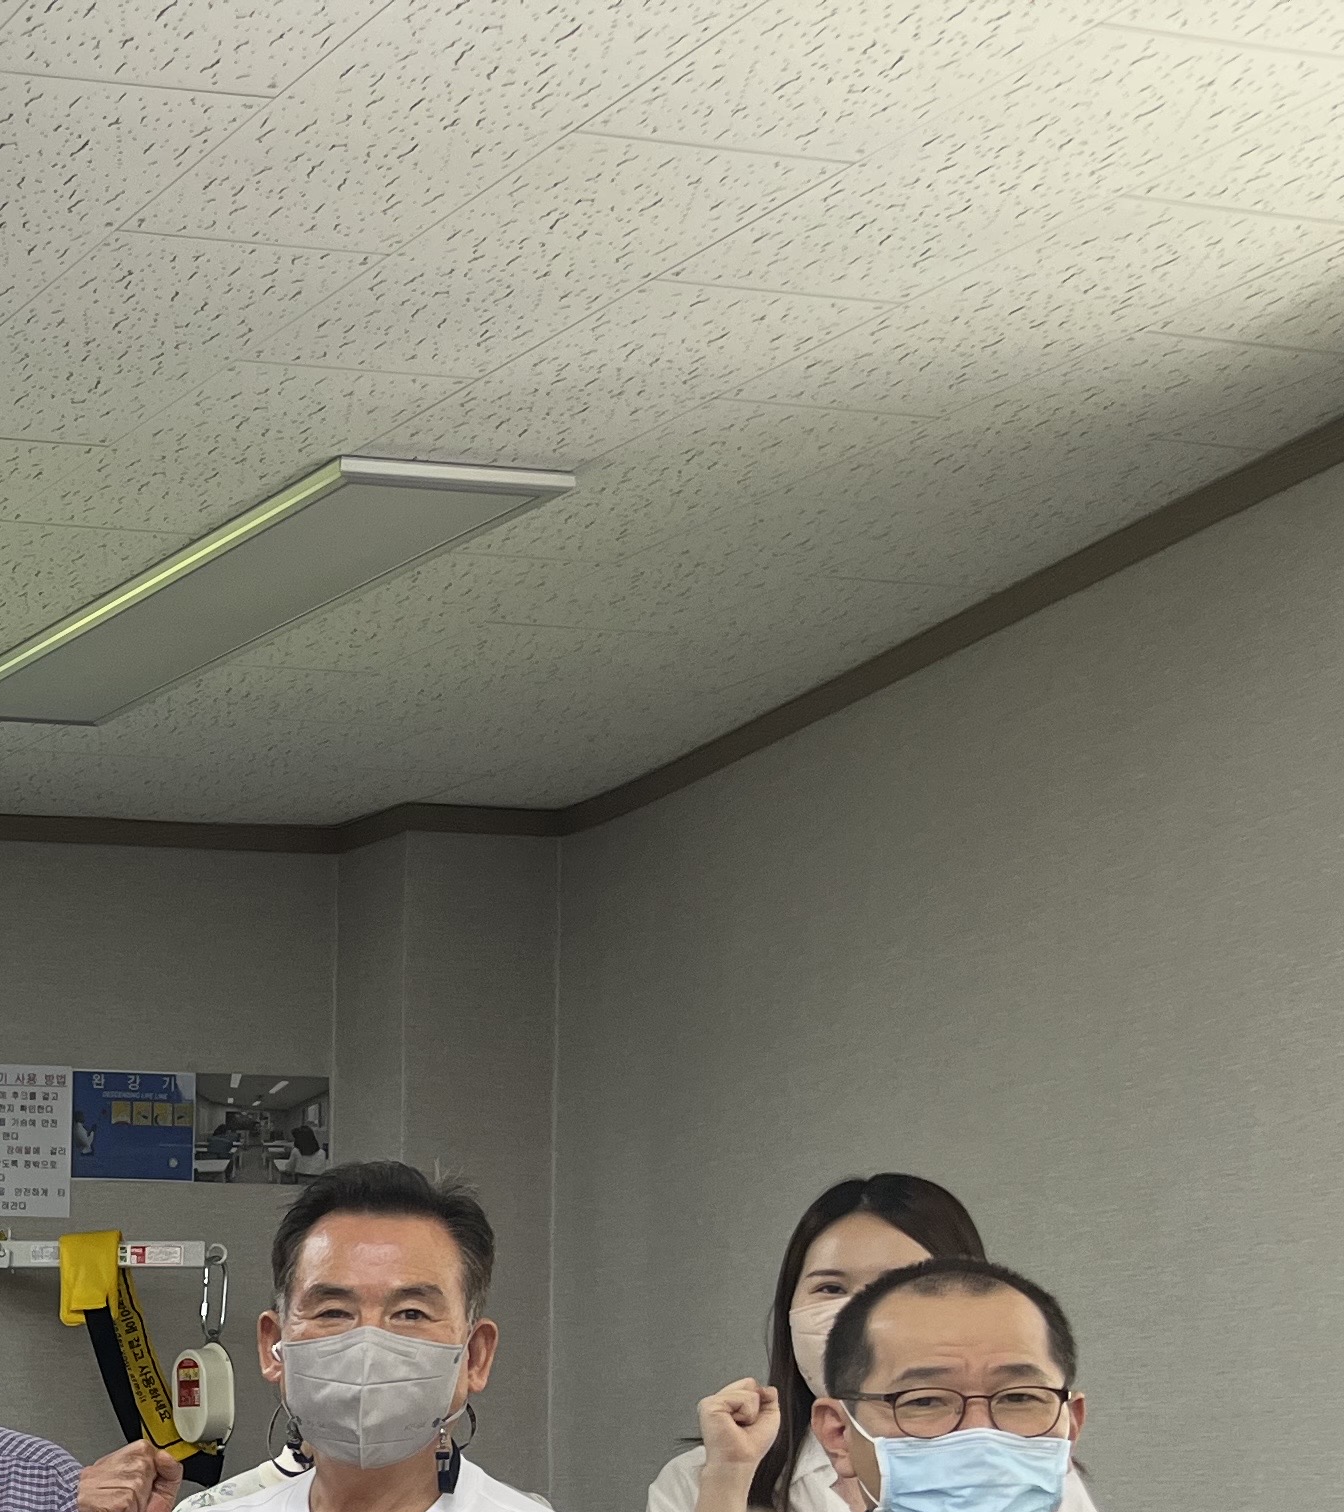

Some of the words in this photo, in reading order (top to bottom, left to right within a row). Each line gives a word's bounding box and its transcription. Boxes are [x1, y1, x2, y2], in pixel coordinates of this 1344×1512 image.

[15, 1072, 37, 1085] 사용
[44, 1074, 67, 1086] 방법
[128, 1336, 145, 1362] 걸고
[138, 1364, 172, 1423] 사용하세요
